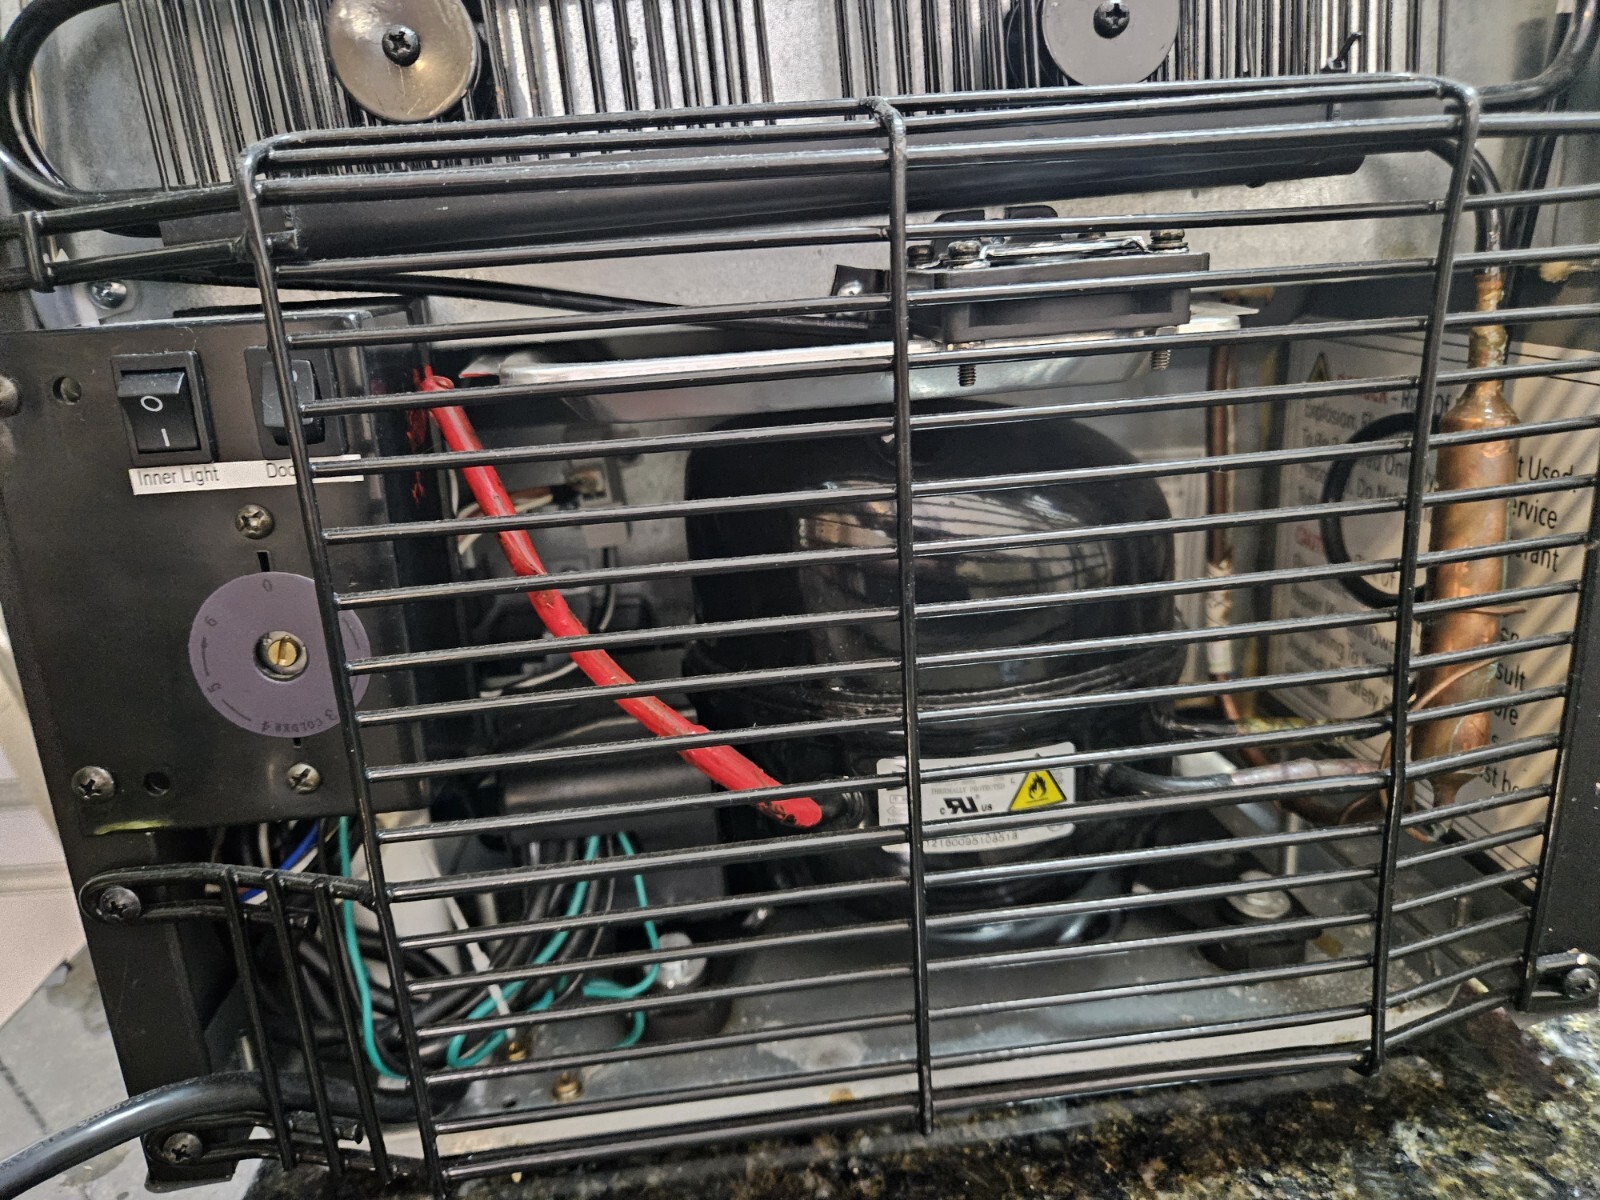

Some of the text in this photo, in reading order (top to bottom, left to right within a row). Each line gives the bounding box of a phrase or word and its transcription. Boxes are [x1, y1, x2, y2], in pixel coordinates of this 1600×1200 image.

[137, 462, 297, 486] Inner Light Doo
